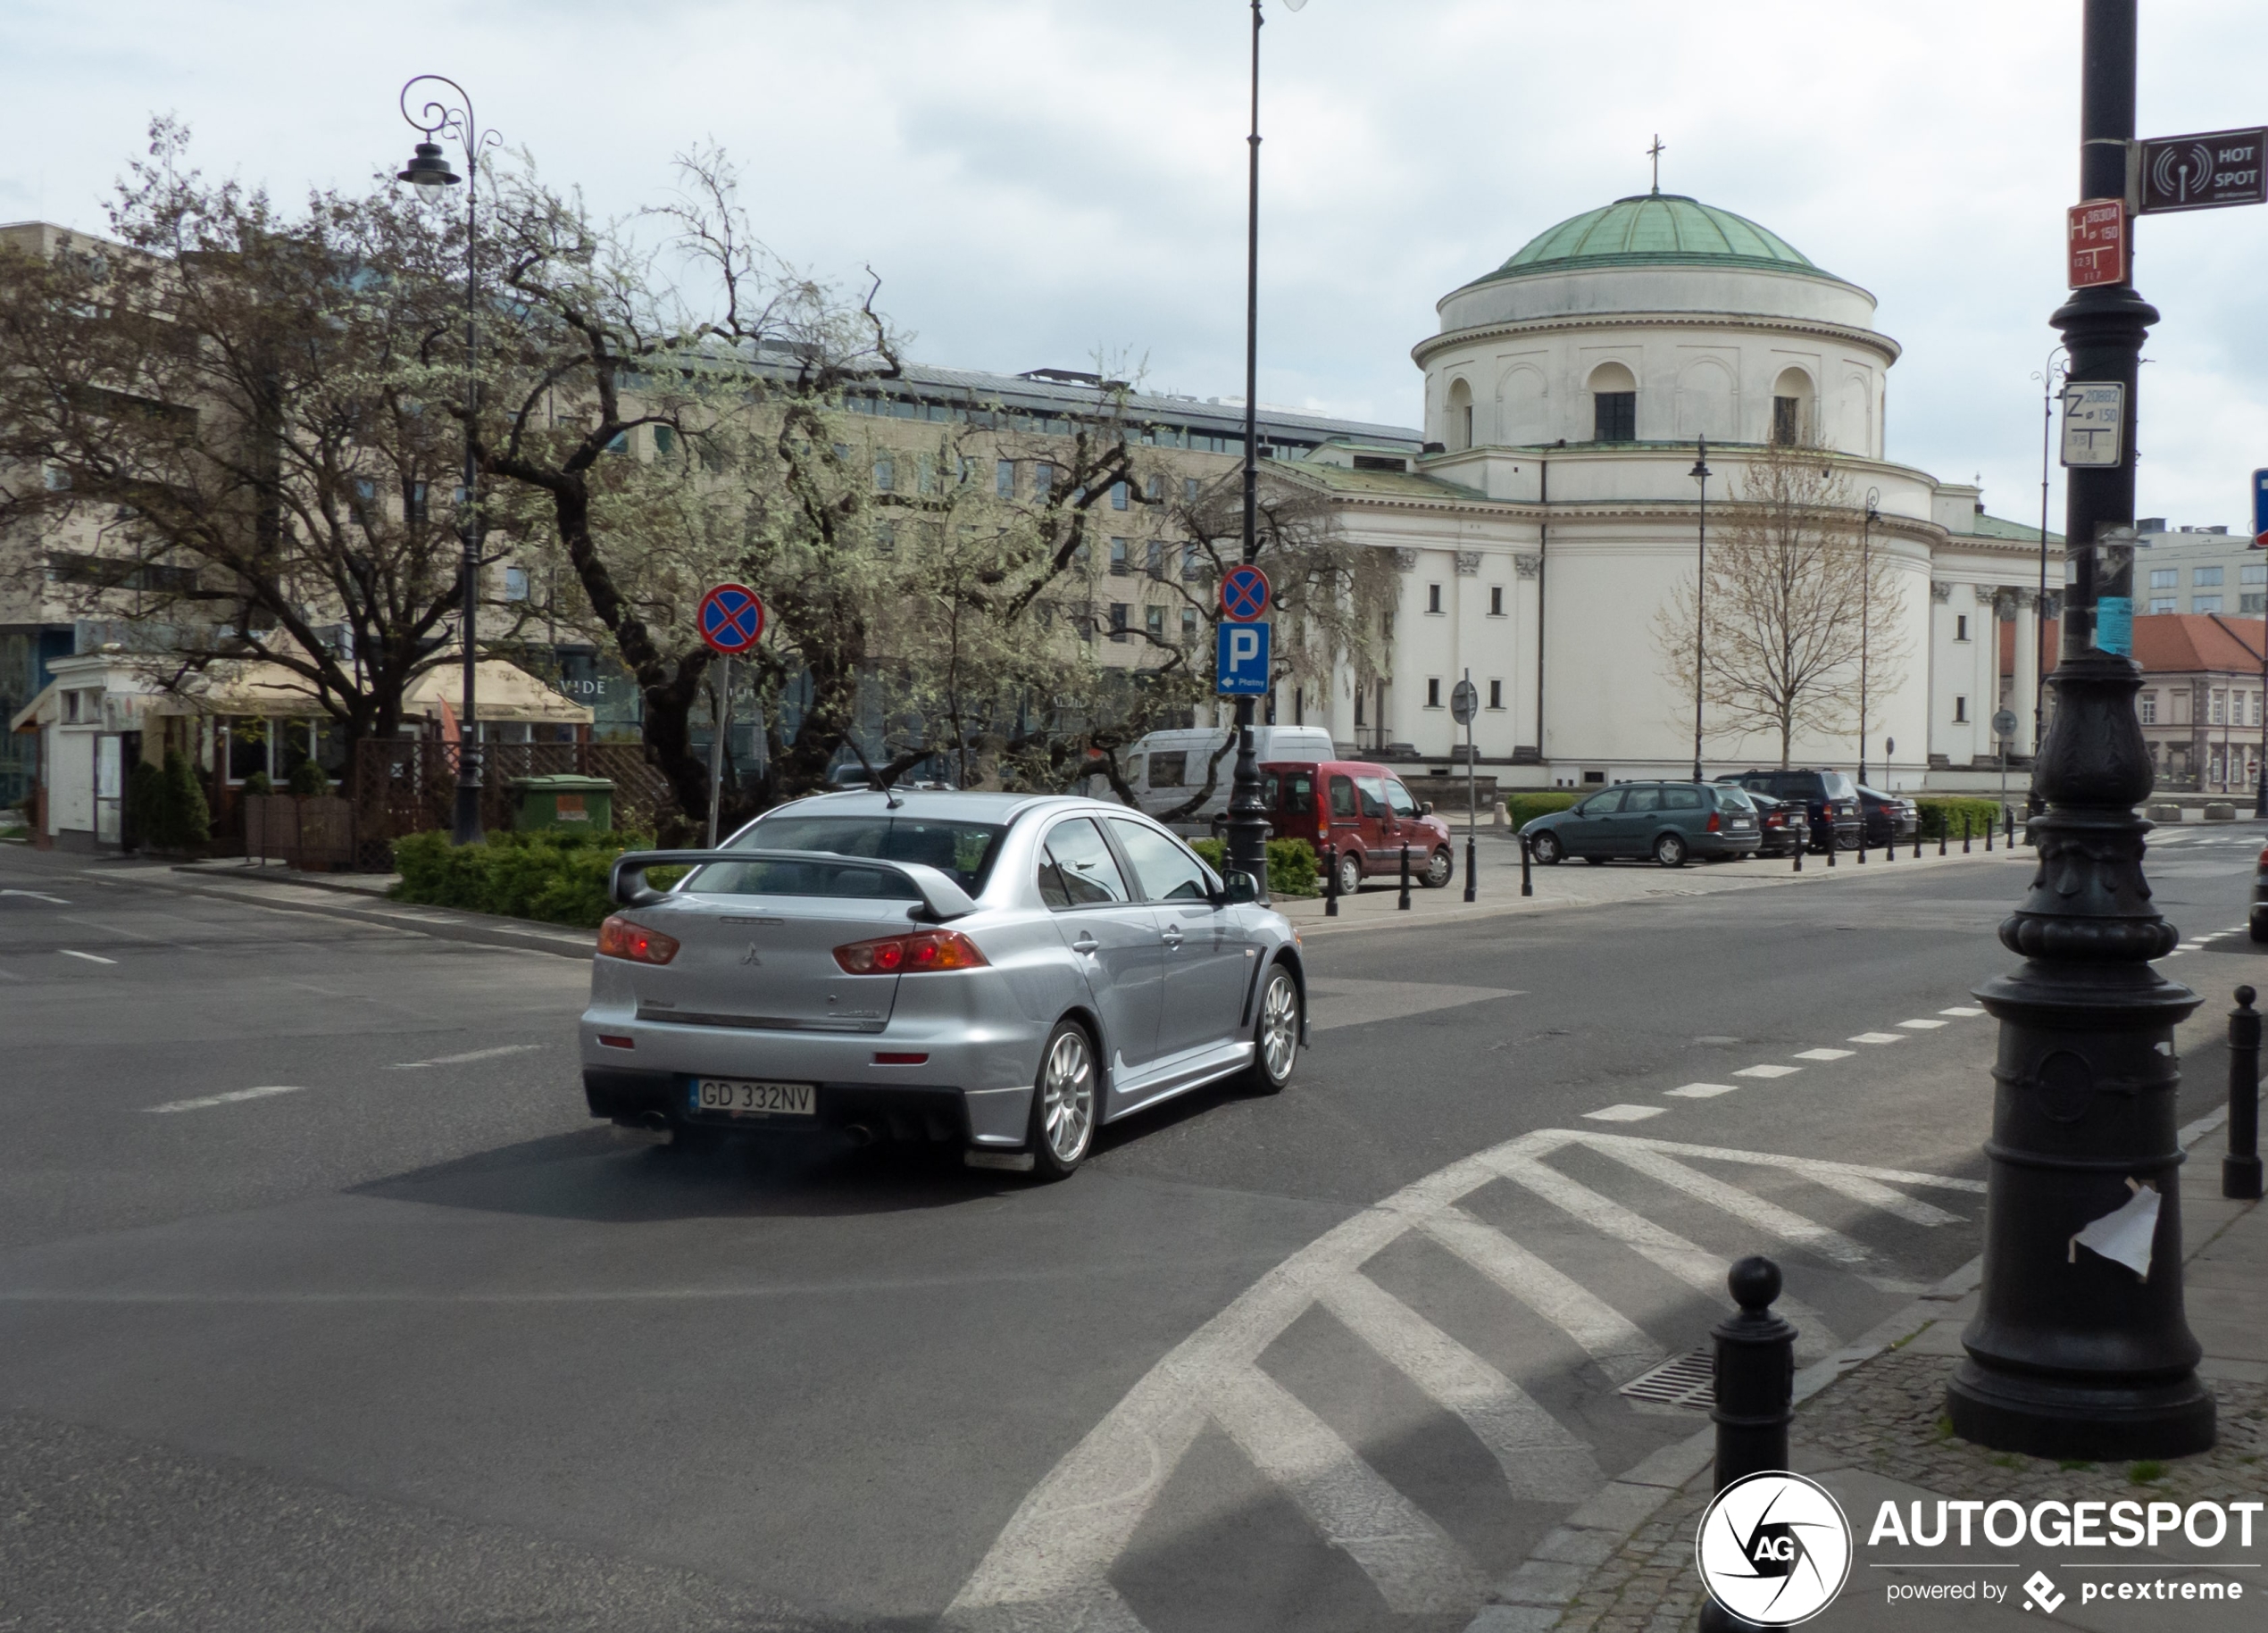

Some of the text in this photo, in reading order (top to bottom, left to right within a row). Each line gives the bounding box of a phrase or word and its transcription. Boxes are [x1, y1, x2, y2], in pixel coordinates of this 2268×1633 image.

[2219, 146, 2255, 163] HOT
[2214, 169, 2258, 187] SPOT
[2071, 215, 2087, 239] H
[2101, 225, 2118, 240] 150
[2066, 394, 2084, 417] Z
[2099, 408, 2117, 422] 150
[1230, 629, 1259, 672] P
[703, 1082, 809, 1111] GD 332NV
